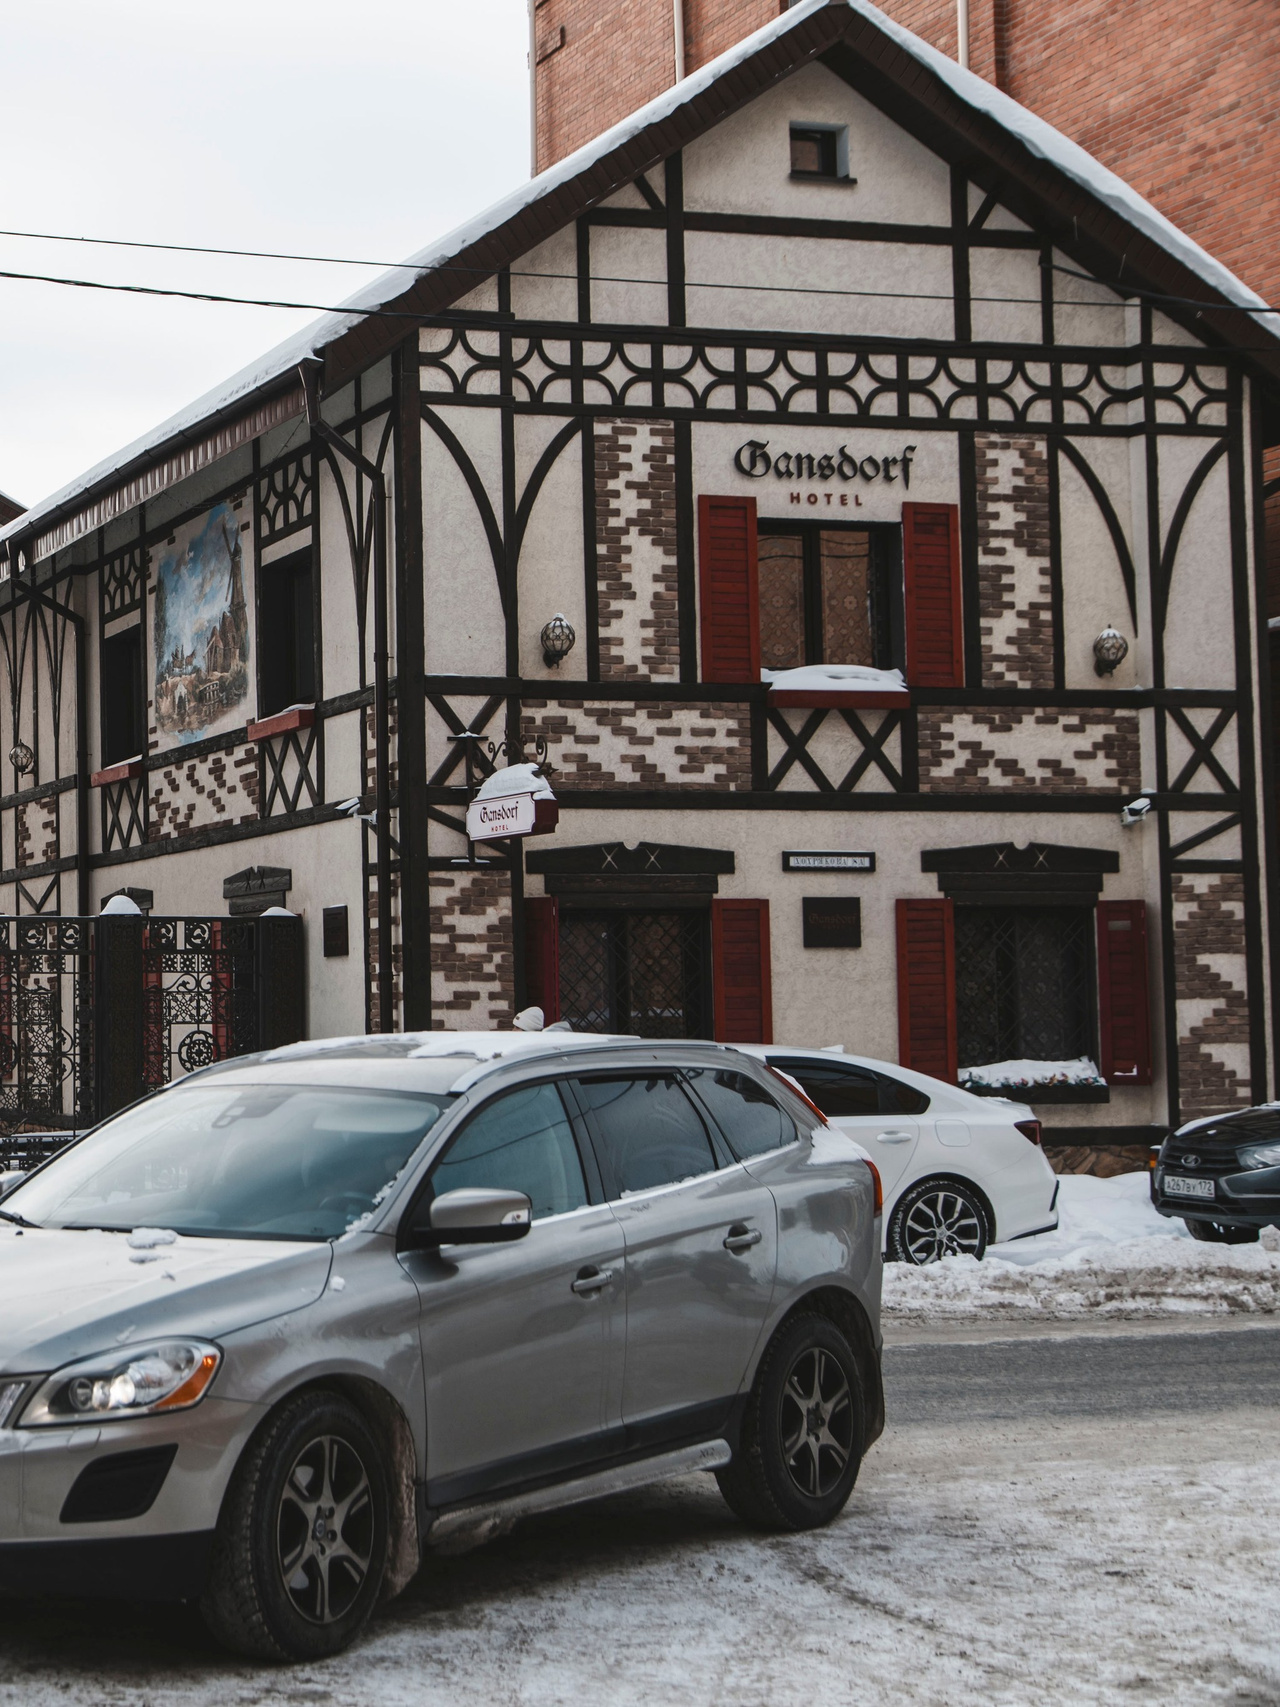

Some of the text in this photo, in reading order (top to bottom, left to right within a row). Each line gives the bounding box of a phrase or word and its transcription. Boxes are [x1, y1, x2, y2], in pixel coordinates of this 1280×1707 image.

[734, 439, 917, 490] Gansdorf
[790, 492, 863, 507] HOTEL
[479, 801, 519, 823] Gansdorf
[491, 824, 509, 832] HOTEL
[1198, 1180, 1212, 1192] 172
